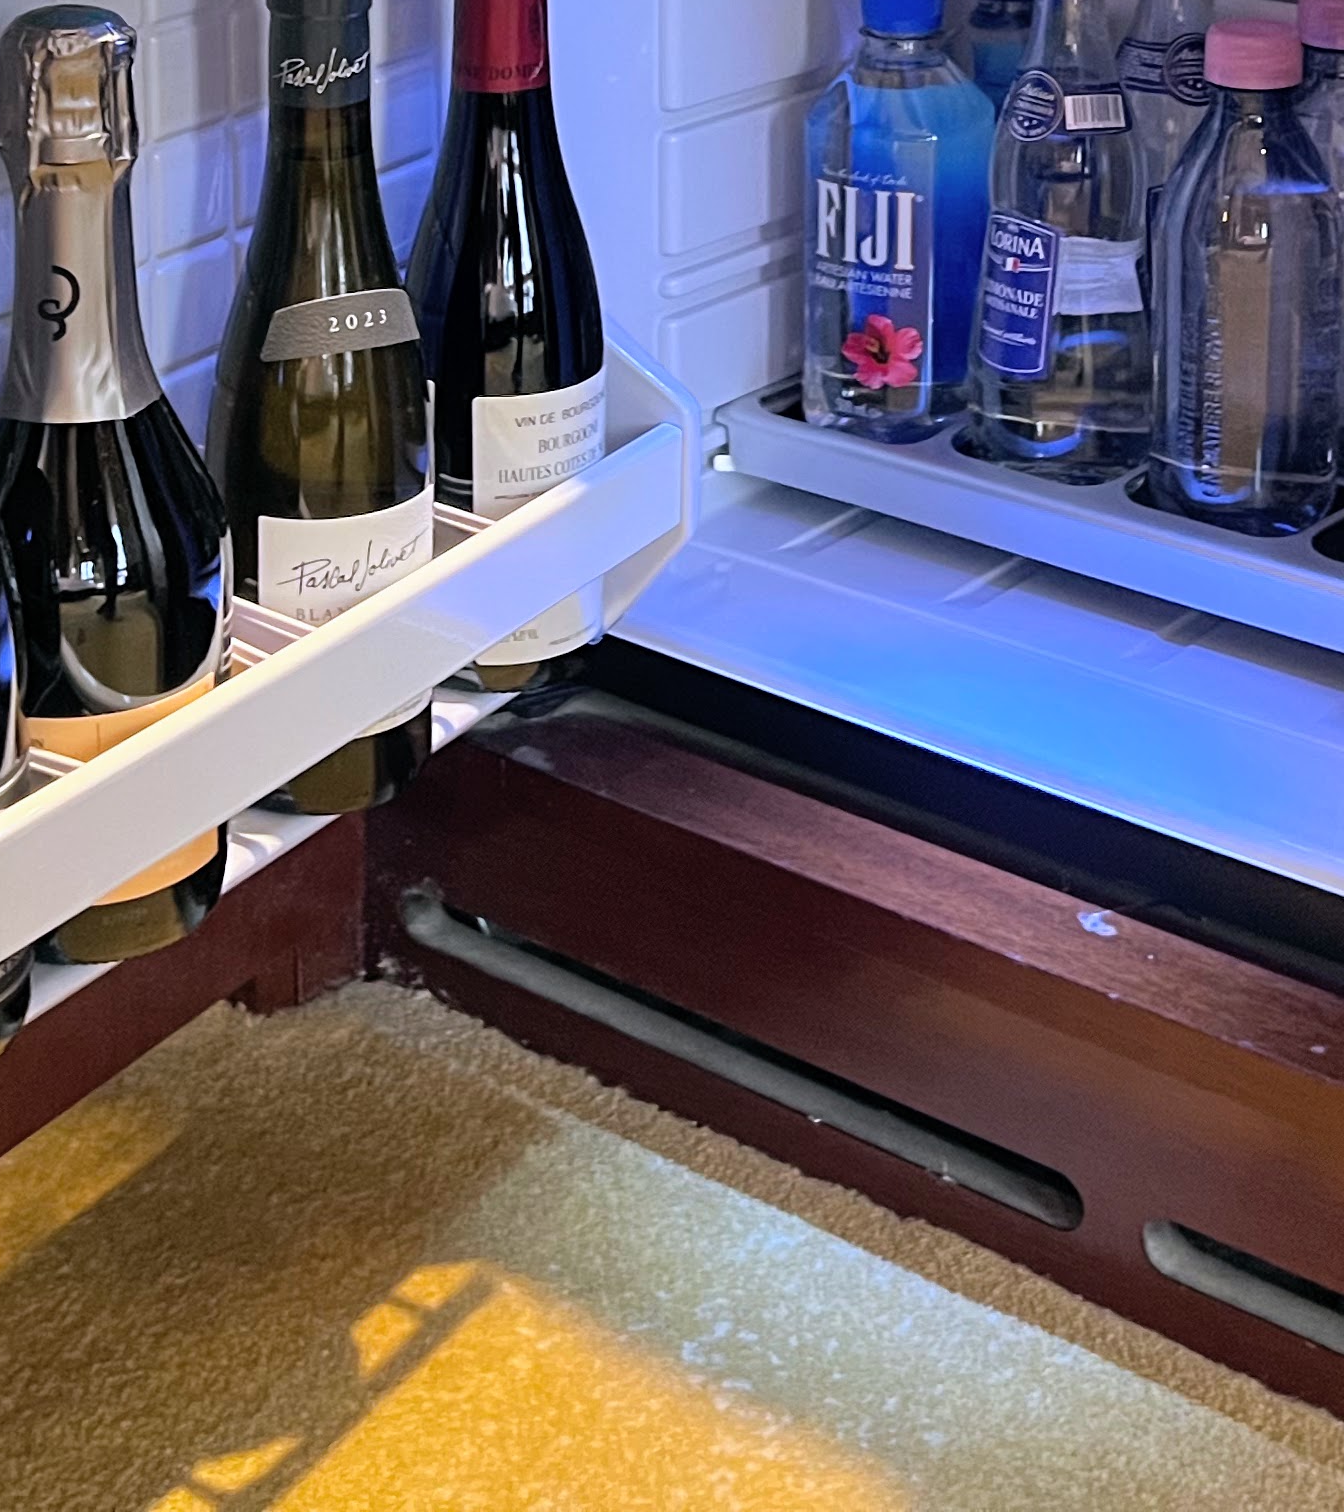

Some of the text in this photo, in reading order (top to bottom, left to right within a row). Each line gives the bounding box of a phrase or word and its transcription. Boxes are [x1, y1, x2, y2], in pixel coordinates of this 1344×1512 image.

[816, 178, 916, 270] FIJI
[990, 224, 1045, 260] LORINA
[870, 270, 913, 287] WATER
[328, 309, 387, 333] 2023
[514, 416, 537, 428] VIN
[540, 412, 556, 425] DE
[498, 463, 552, 484] HAUTES
[276, 525, 430, 596] Pascal Jolivet
